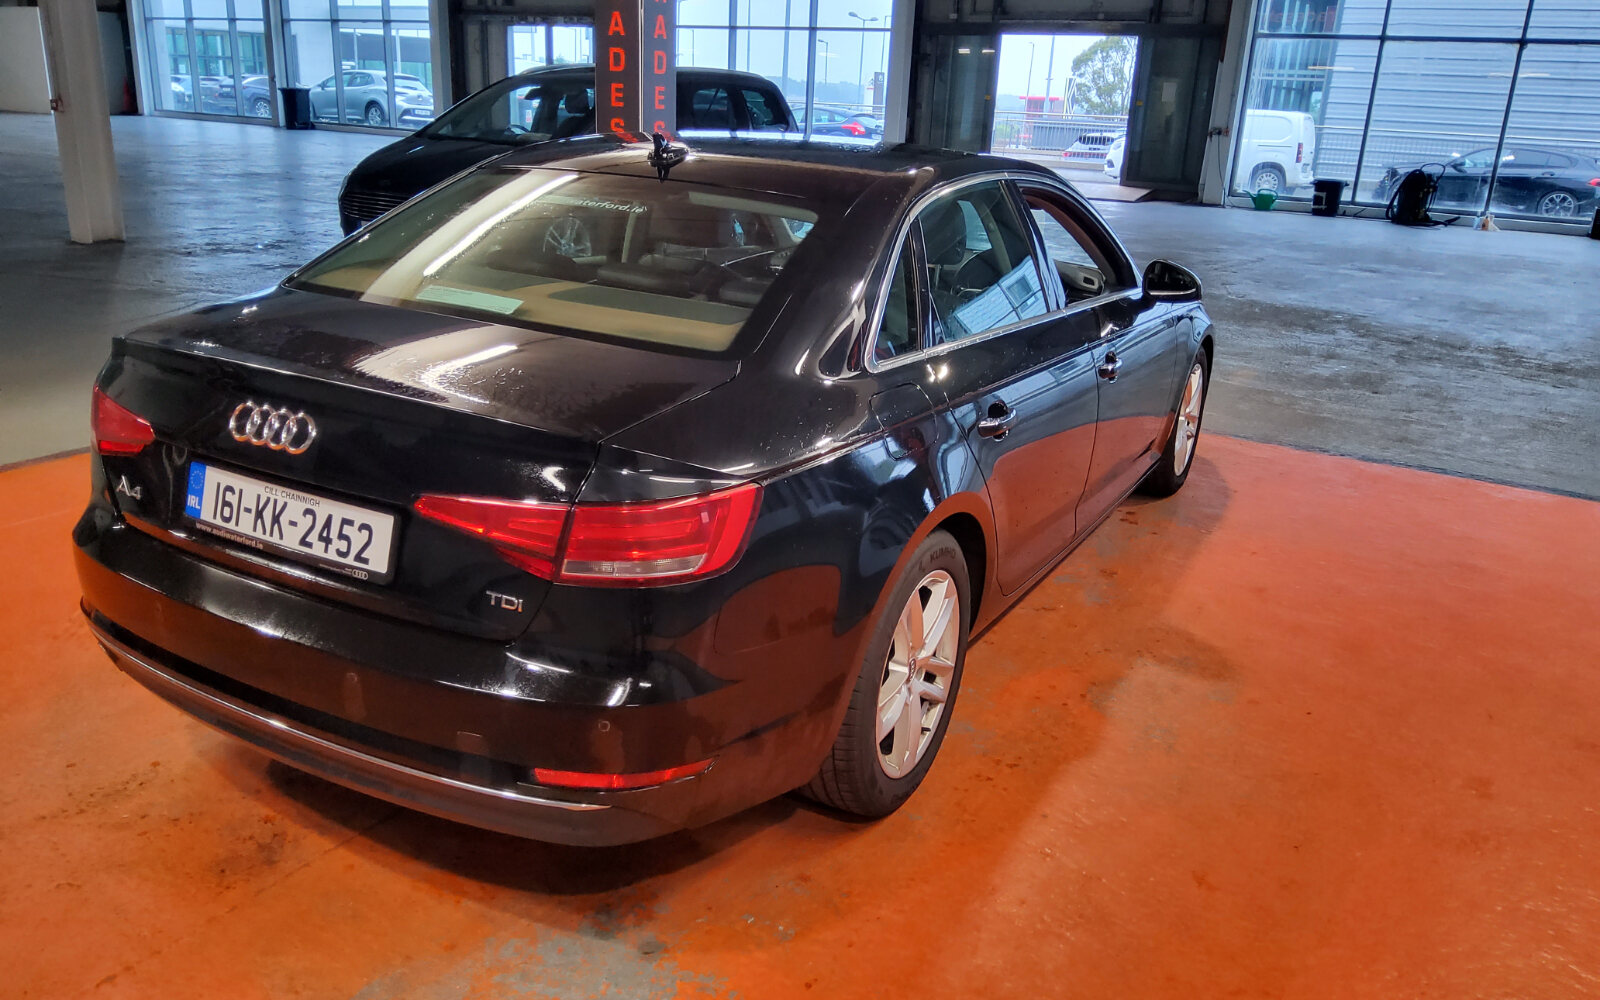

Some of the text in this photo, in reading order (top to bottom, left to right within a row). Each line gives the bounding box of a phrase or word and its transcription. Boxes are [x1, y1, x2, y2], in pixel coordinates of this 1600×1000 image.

[653, 0, 667, 133] ADES
[116, 474, 141, 500] A4
[264, 486, 320, 507] CILL CHAINNIGH
[187, 494, 201, 510] IRL
[213, 482, 374, 565] 161-KK-2452
